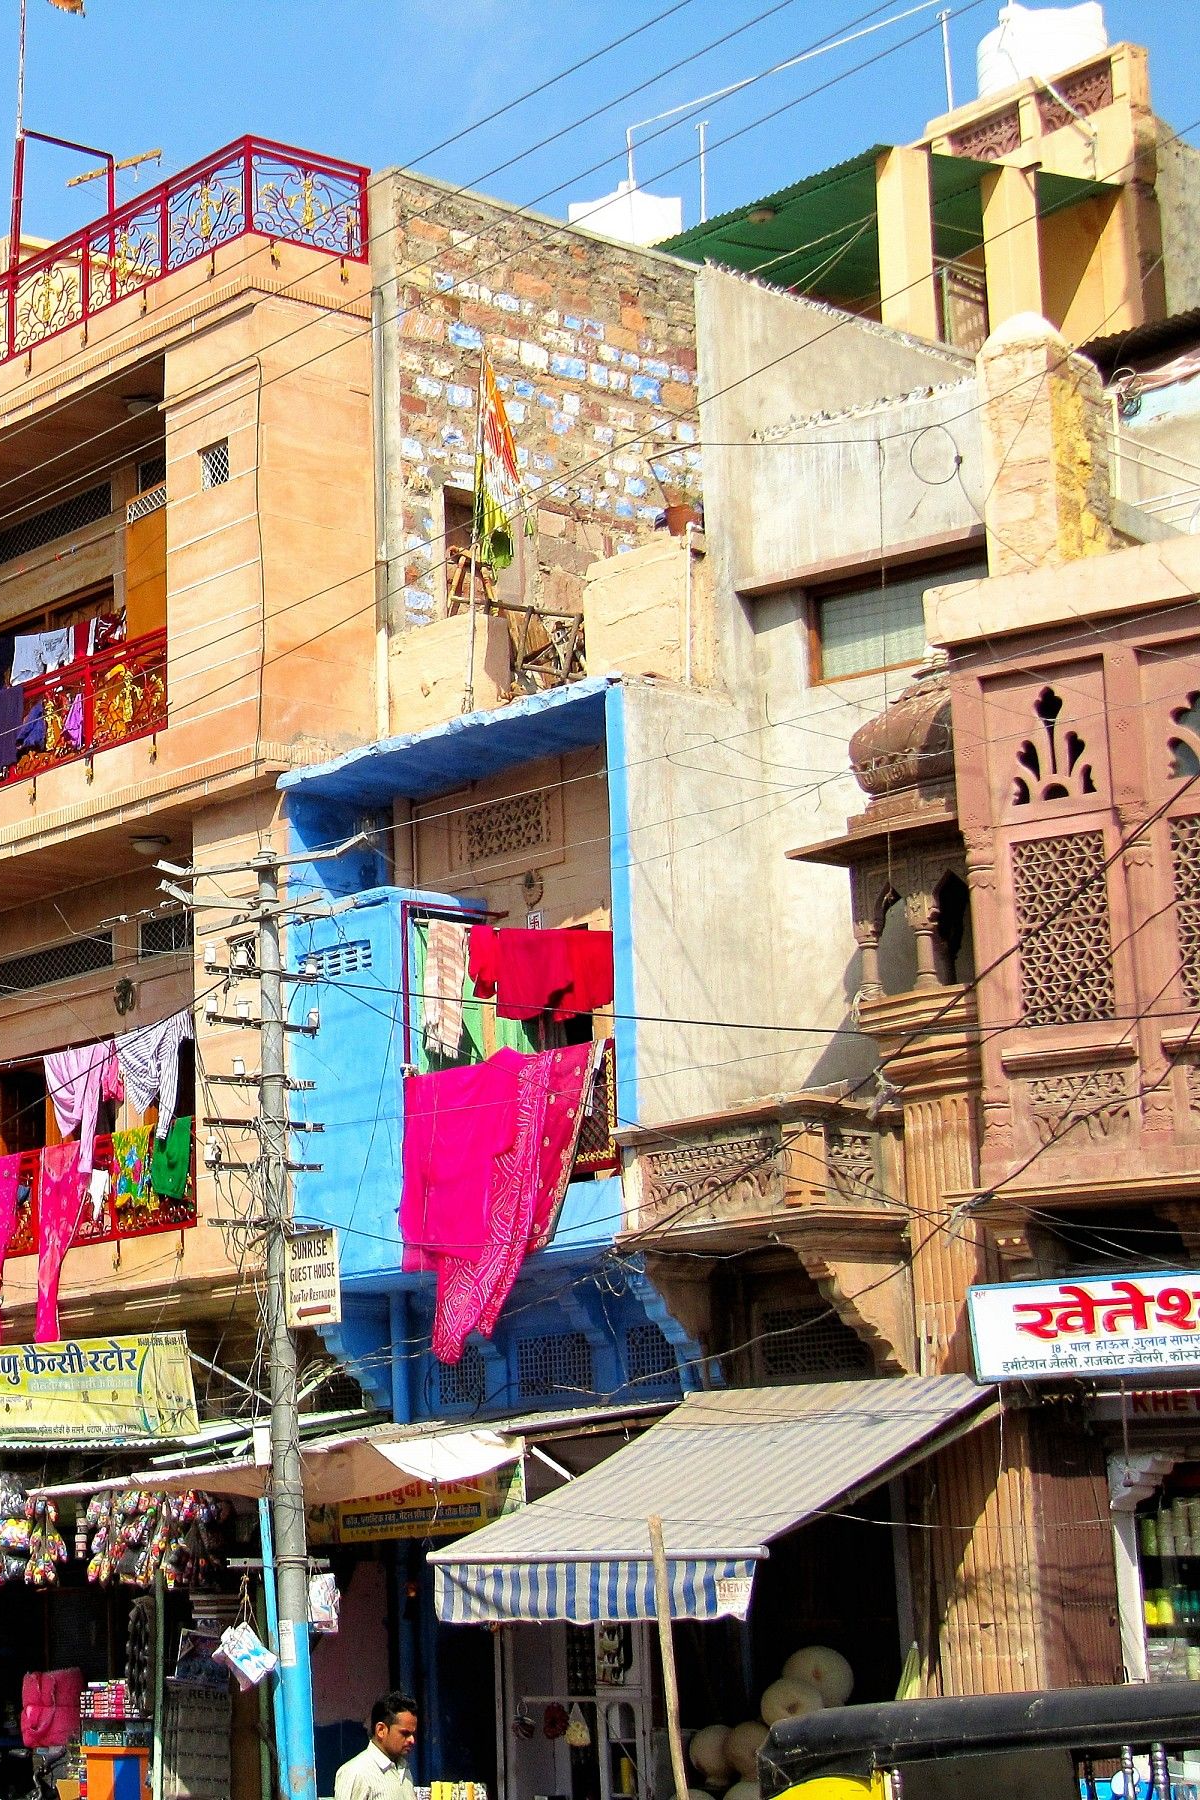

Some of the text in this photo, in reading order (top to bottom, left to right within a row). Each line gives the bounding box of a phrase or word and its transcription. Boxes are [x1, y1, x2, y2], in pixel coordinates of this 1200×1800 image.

[291, 1239, 327, 1260] SUNRISE
[289, 1262, 335, 1282] GUEST HOUSE
[23, 1342, 84, 1374] फैन्सी
[87, 1340, 138, 1372] स्टोर
